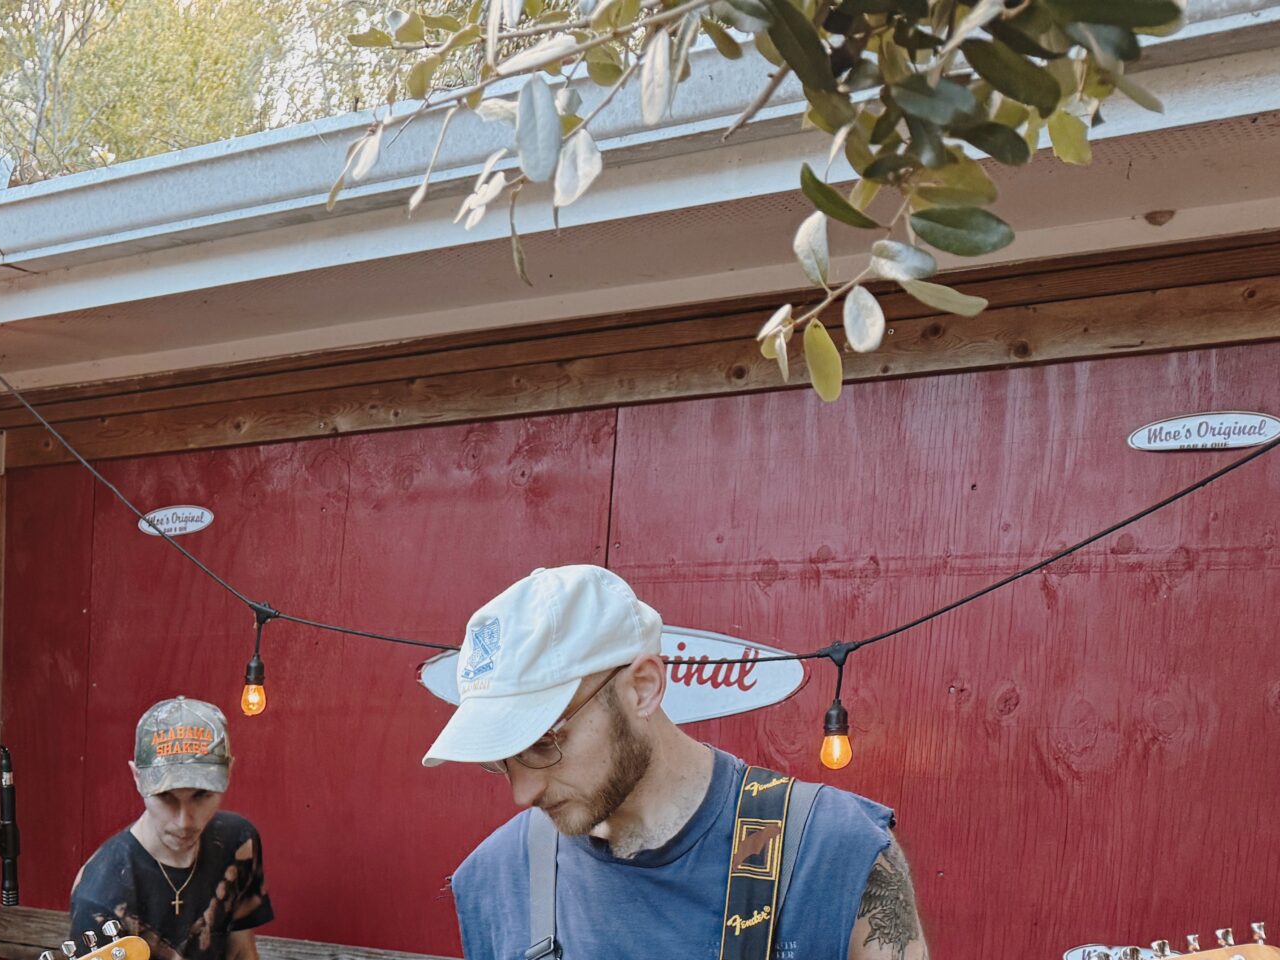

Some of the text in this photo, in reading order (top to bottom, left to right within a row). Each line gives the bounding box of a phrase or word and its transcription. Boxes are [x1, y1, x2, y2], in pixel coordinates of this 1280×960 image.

[1146, 419, 1269, 445] Moe's Original
[171, 511, 205, 526] Original
[151, 725, 213, 746] ALABAMA
